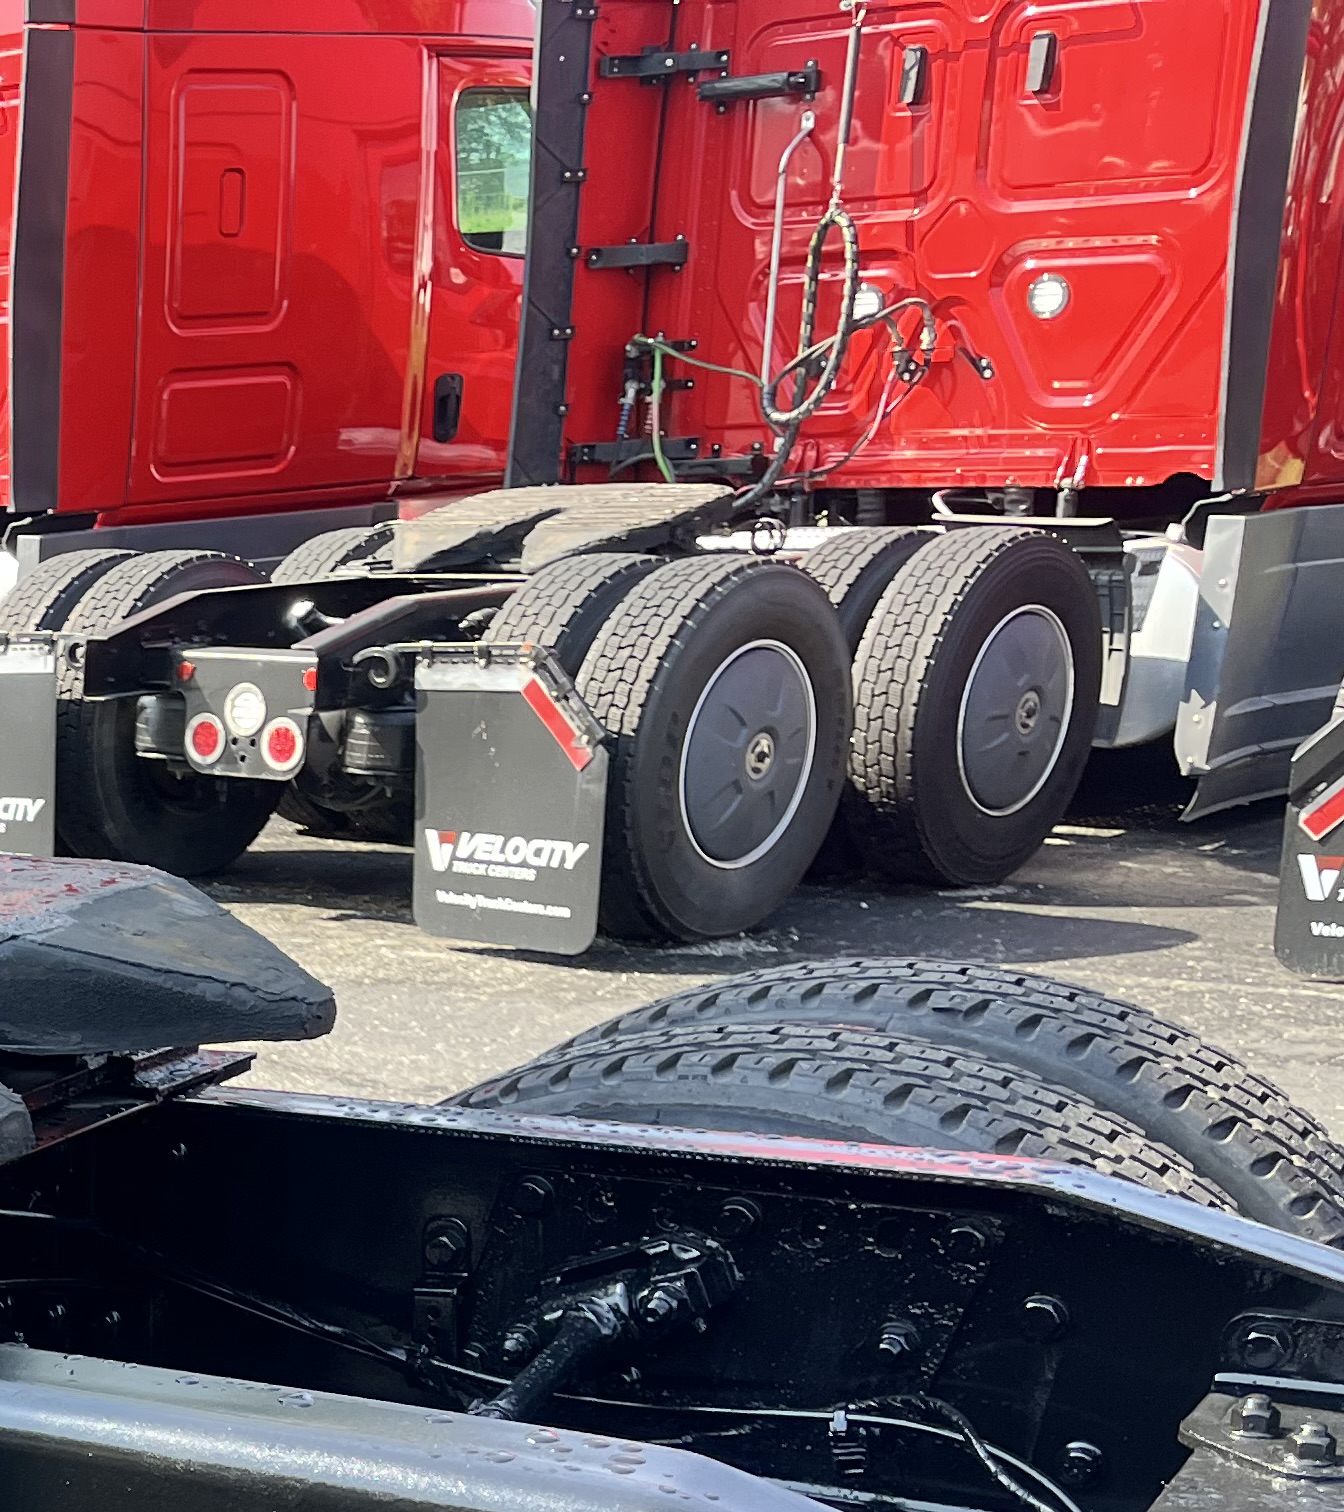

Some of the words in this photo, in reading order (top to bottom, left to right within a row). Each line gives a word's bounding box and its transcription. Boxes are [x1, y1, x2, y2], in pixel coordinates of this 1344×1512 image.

[455, 831, 590, 871] VELOCITY
[451, 860, 489, 876] TRUCK
[487, 864, 538, 882] CENTERS
